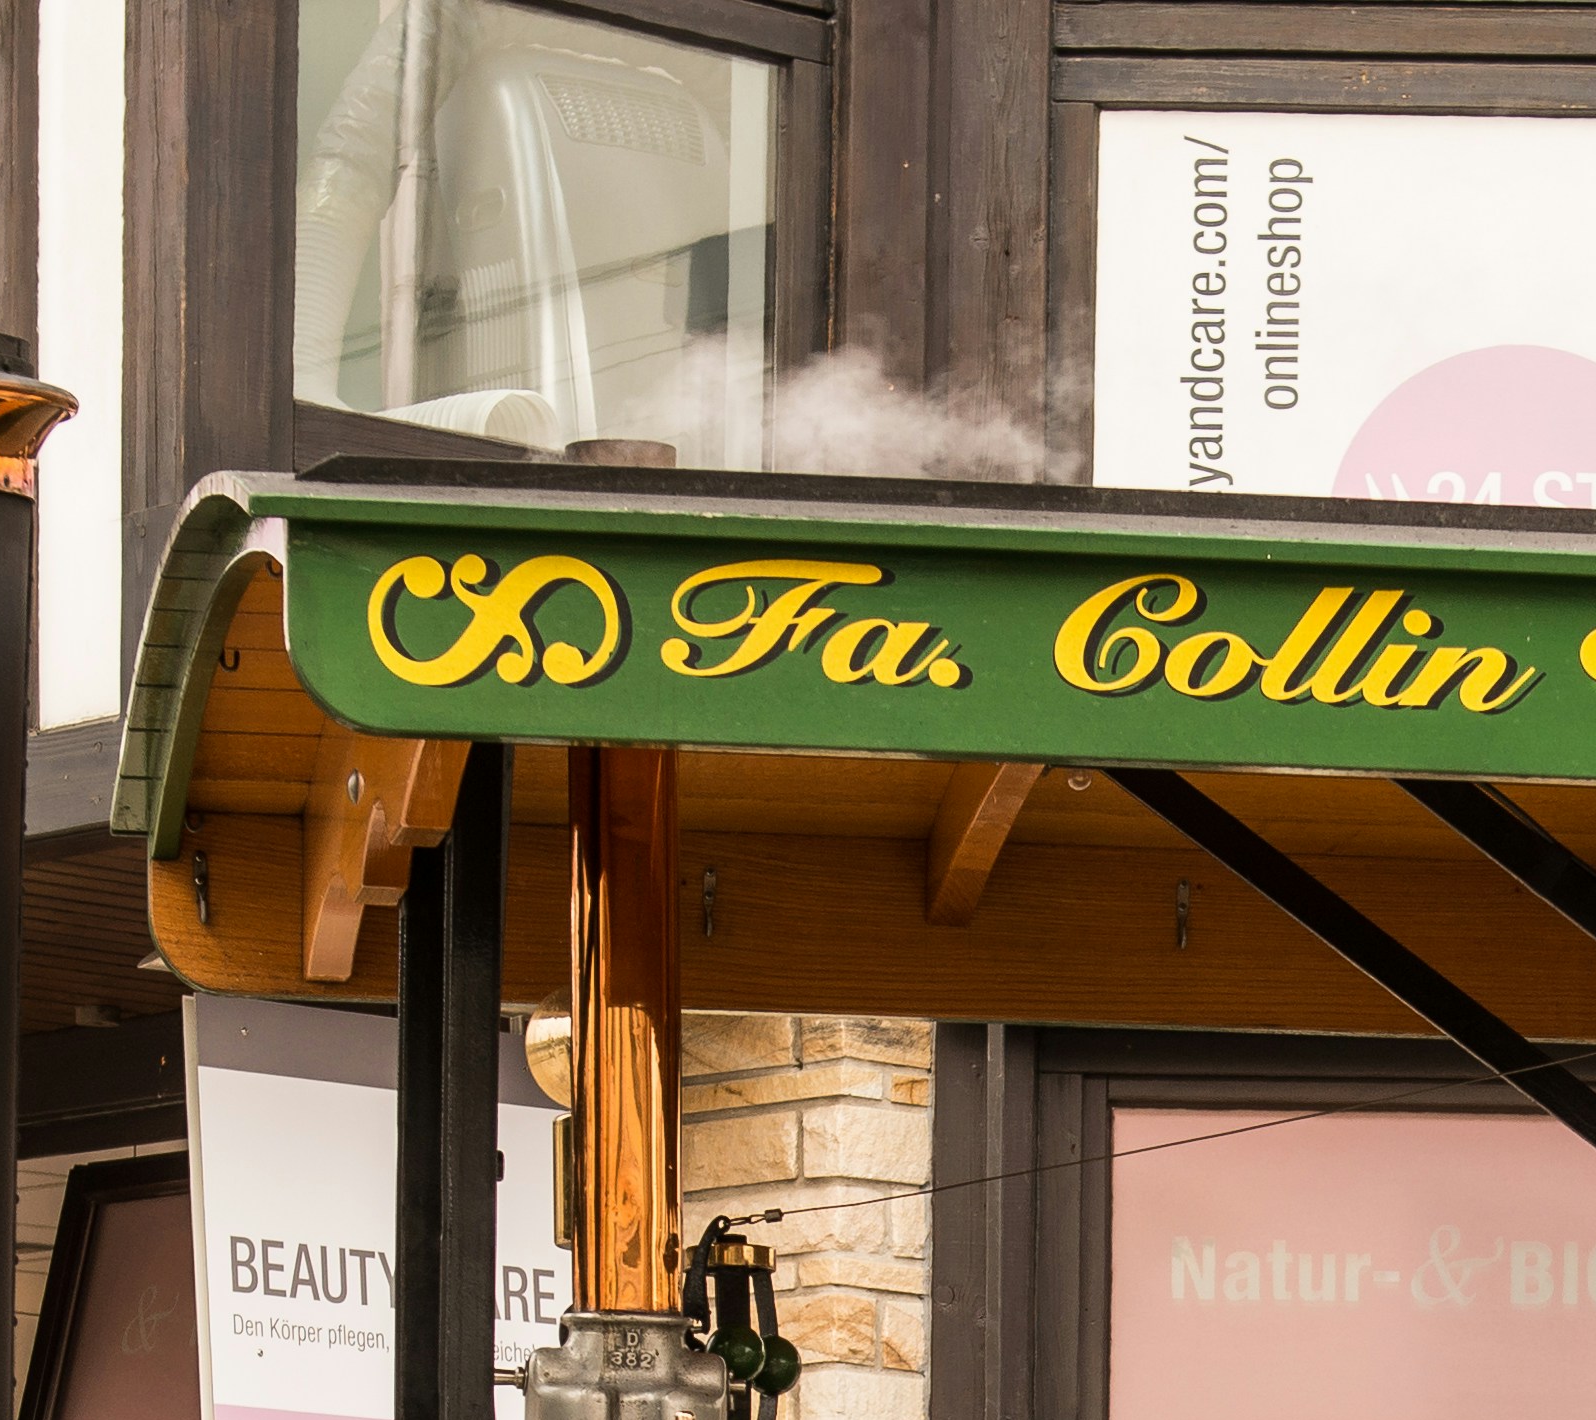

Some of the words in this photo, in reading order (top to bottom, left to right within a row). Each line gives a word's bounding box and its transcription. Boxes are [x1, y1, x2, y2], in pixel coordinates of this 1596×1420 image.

[1182, 137, 1233, 491] yandcare.com/
[1256, 158, 1312, 410] onlineshop
[660, 559, 962, 690] Fa.
[1053, 573, 1536, 714] Collin
[229, 1235, 396, 1309] BEAUTY
[1170, 1235, 1401, 1306] Natur-
[1410, 1224, 1504, 1310] &
[232, 1313, 264, 1338] Den
[270, 1317, 322, 1345] Körper
[327, 1323, 390, 1353] pflegen,
[611, 1352, 652, 1368] 382
[627, 1333, 638, 1346] D
